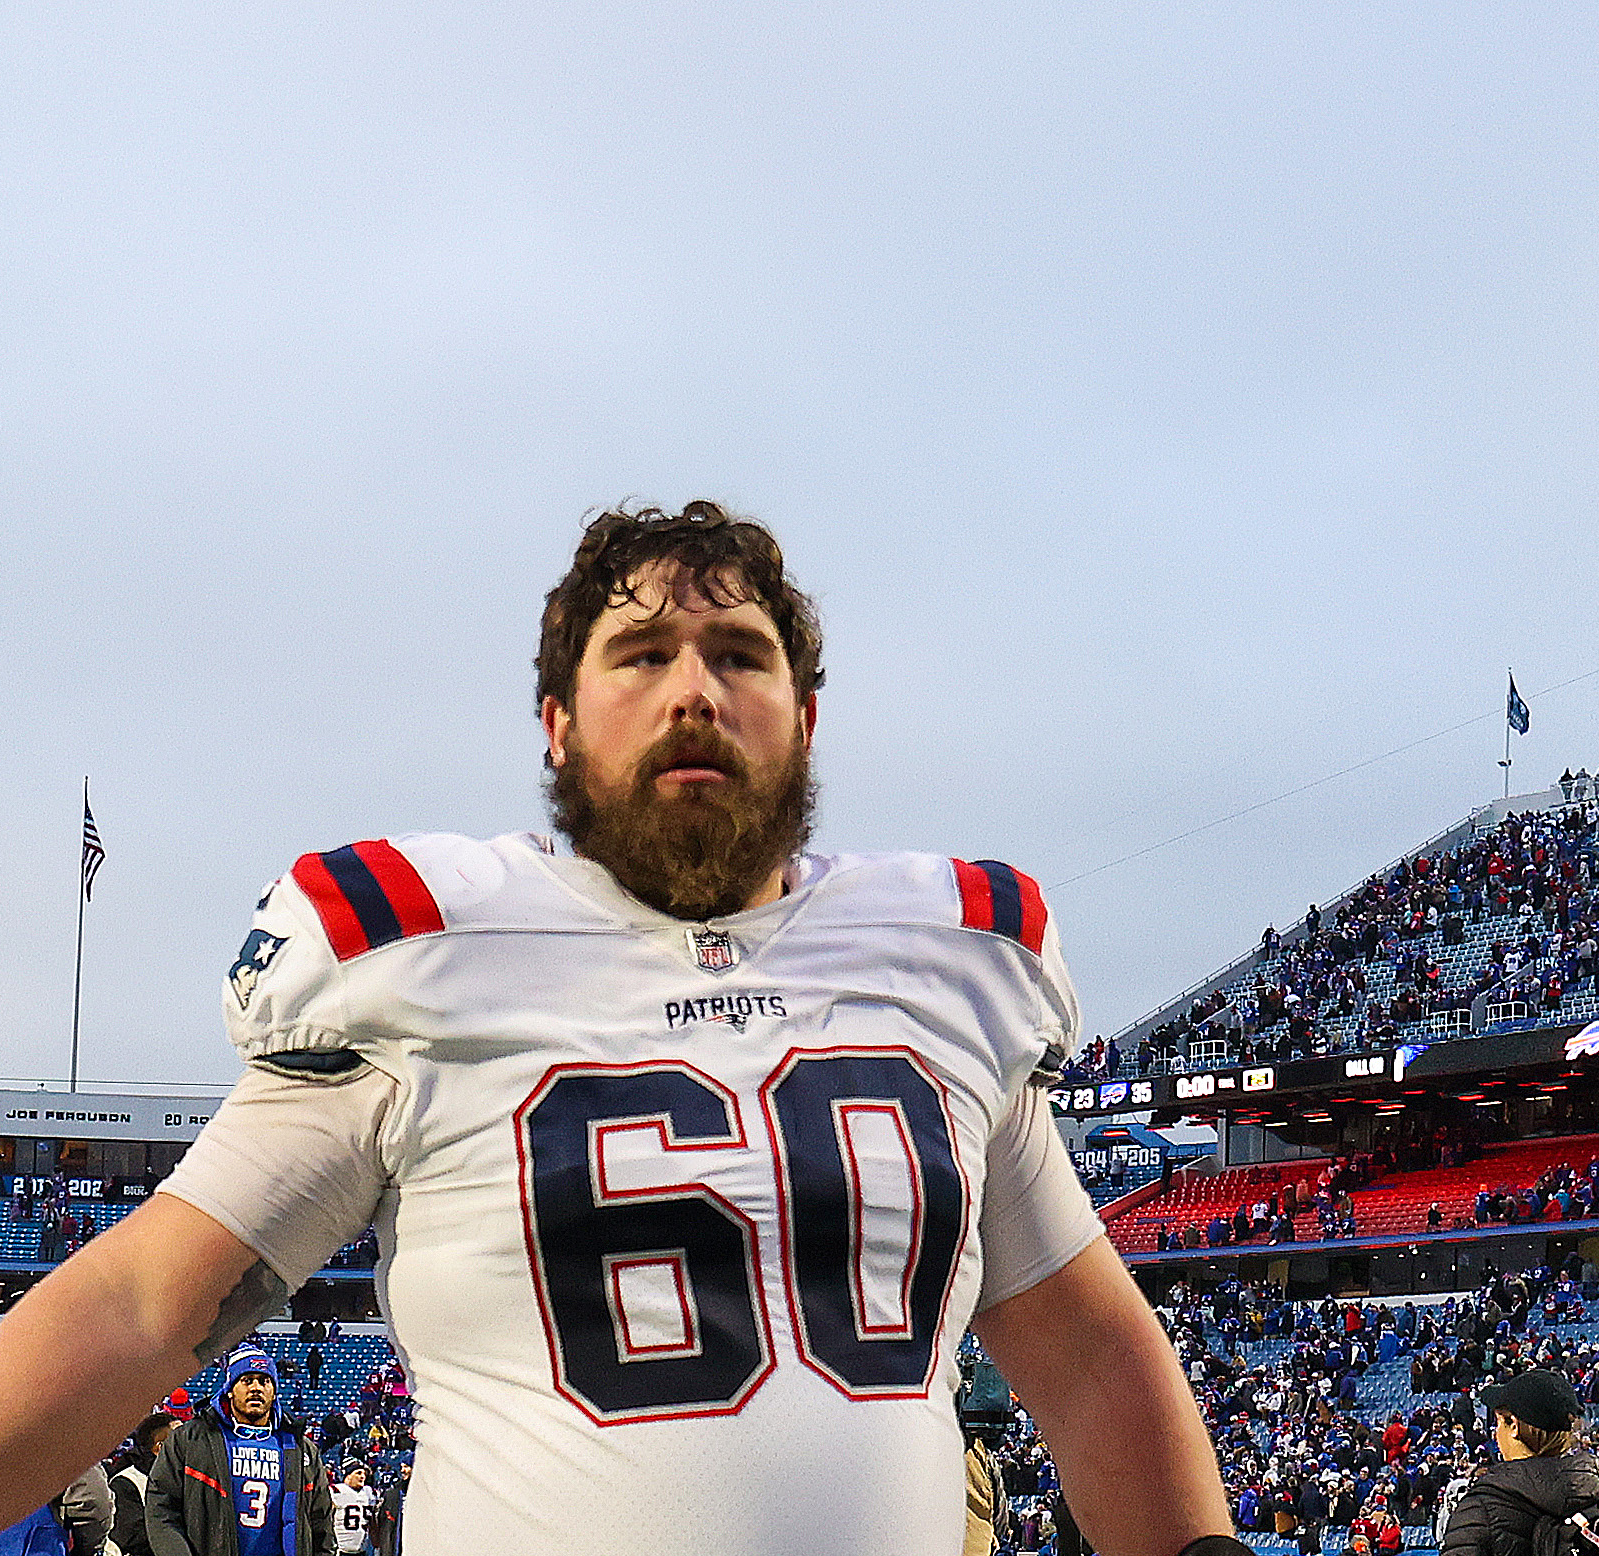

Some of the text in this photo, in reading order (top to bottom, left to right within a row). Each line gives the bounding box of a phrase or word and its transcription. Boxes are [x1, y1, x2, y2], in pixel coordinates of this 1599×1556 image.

[666, 995, 787, 1028] PATRIOTS
[1132, 1083, 1152, 1103] 35
[1176, 1075, 1215, 1098] 0:00
[1073, 1089, 1094, 1109] 23
[6, 1110, 38, 1119] JOE
[46, 1111, 130, 1122] FERGUSON
[164, 1114, 182, 1126] 20
[1127, 1147, 1160, 1167] 205
[69, 1178, 103, 1197] 202
[513, 1046, 970, 1427] 60
[232, 1447, 279, 1460] LOVE FOR
[232, 1459, 280, 1481] DAMAR
[239, 1480, 269, 1529] 3
